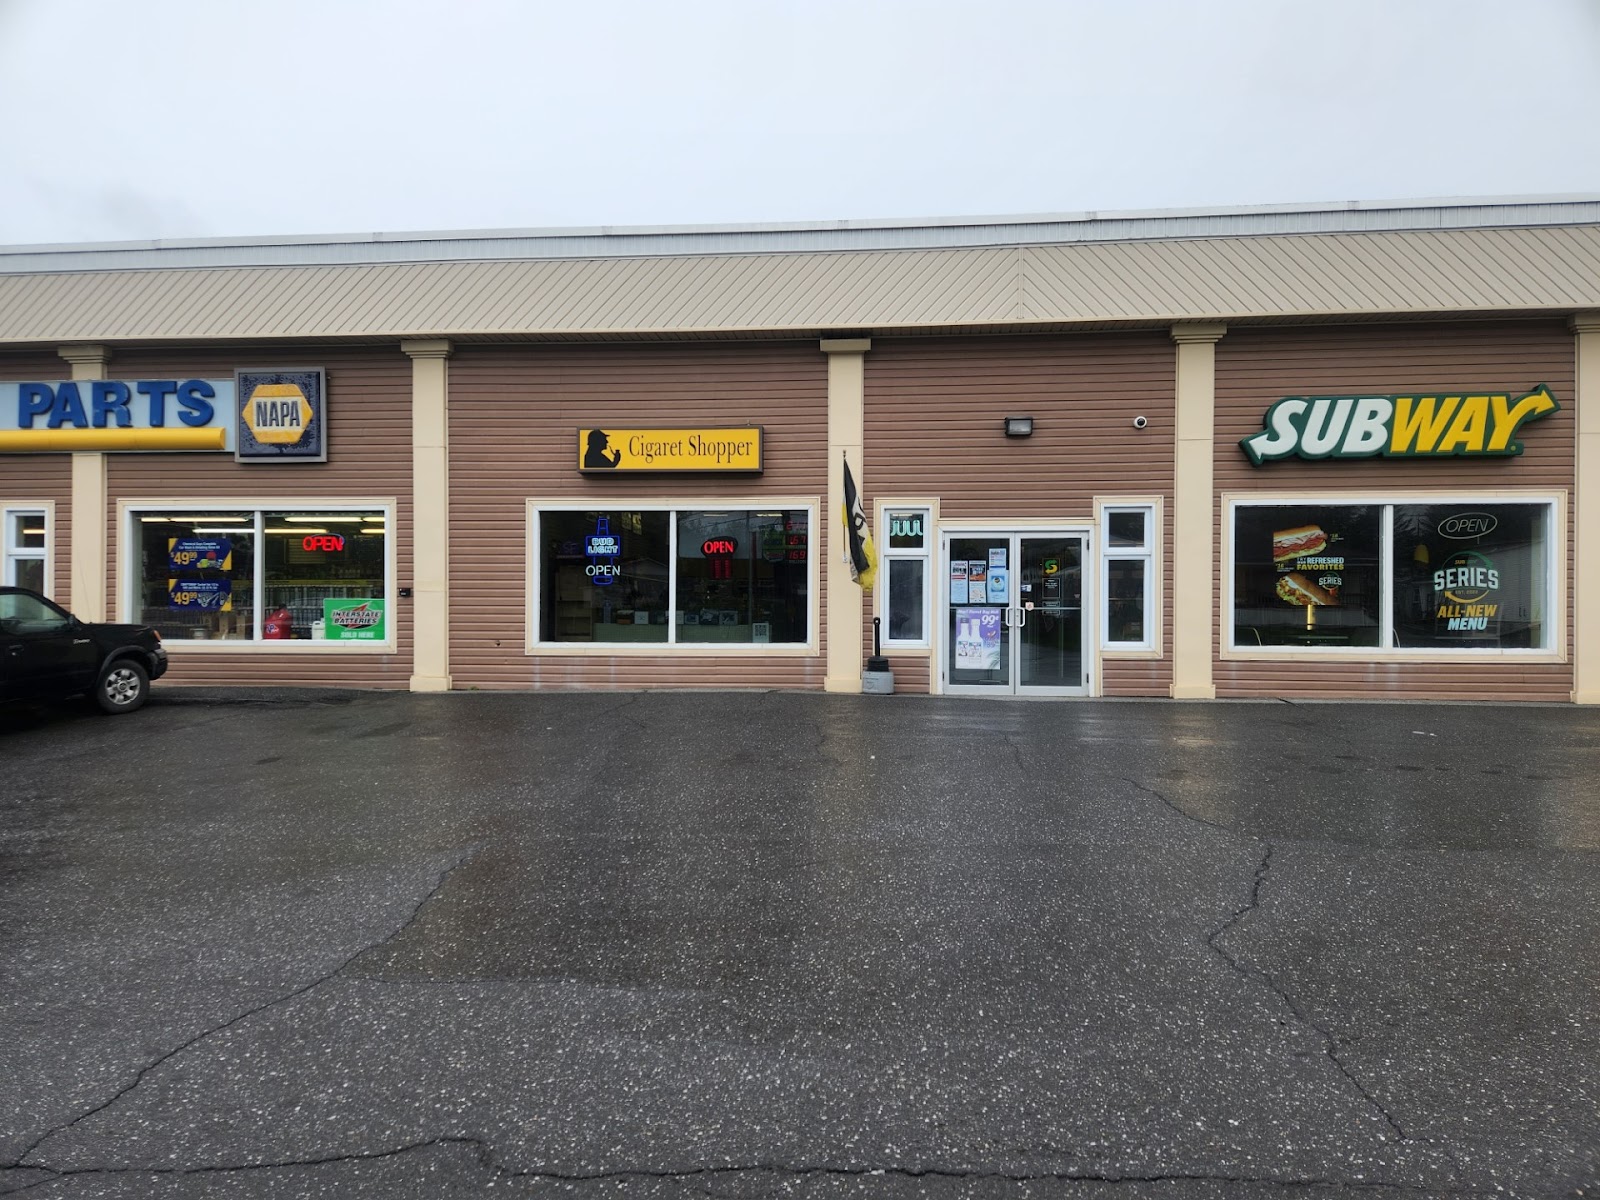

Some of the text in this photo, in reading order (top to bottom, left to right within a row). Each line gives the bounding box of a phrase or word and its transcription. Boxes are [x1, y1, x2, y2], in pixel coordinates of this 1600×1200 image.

[18, 379, 215, 428] PARTS
[256, 401, 300, 427] NAPA
[1249, 389, 1555, 459] SUBWAY
[629, 434, 753, 463] Cigaret Shopper
[1446, 518, 1488, 533] OPEN
[303, 536, 343, 551] OPEN
[591, 537, 614, 546] BUD
[704, 541, 733, 554] OPEN
[588, 545, 618, 554] LIGHT
[585, 565, 620, 576] OPEN
[1319, 576, 1342, 586] SERIES
[1434, 567, 1499, 591] SERIES
[333, 609, 381, 618] INTERSTATE
[1437, 604, 1497, 618] ALL-NEW
[1447, 617, 1488, 631] MENU
